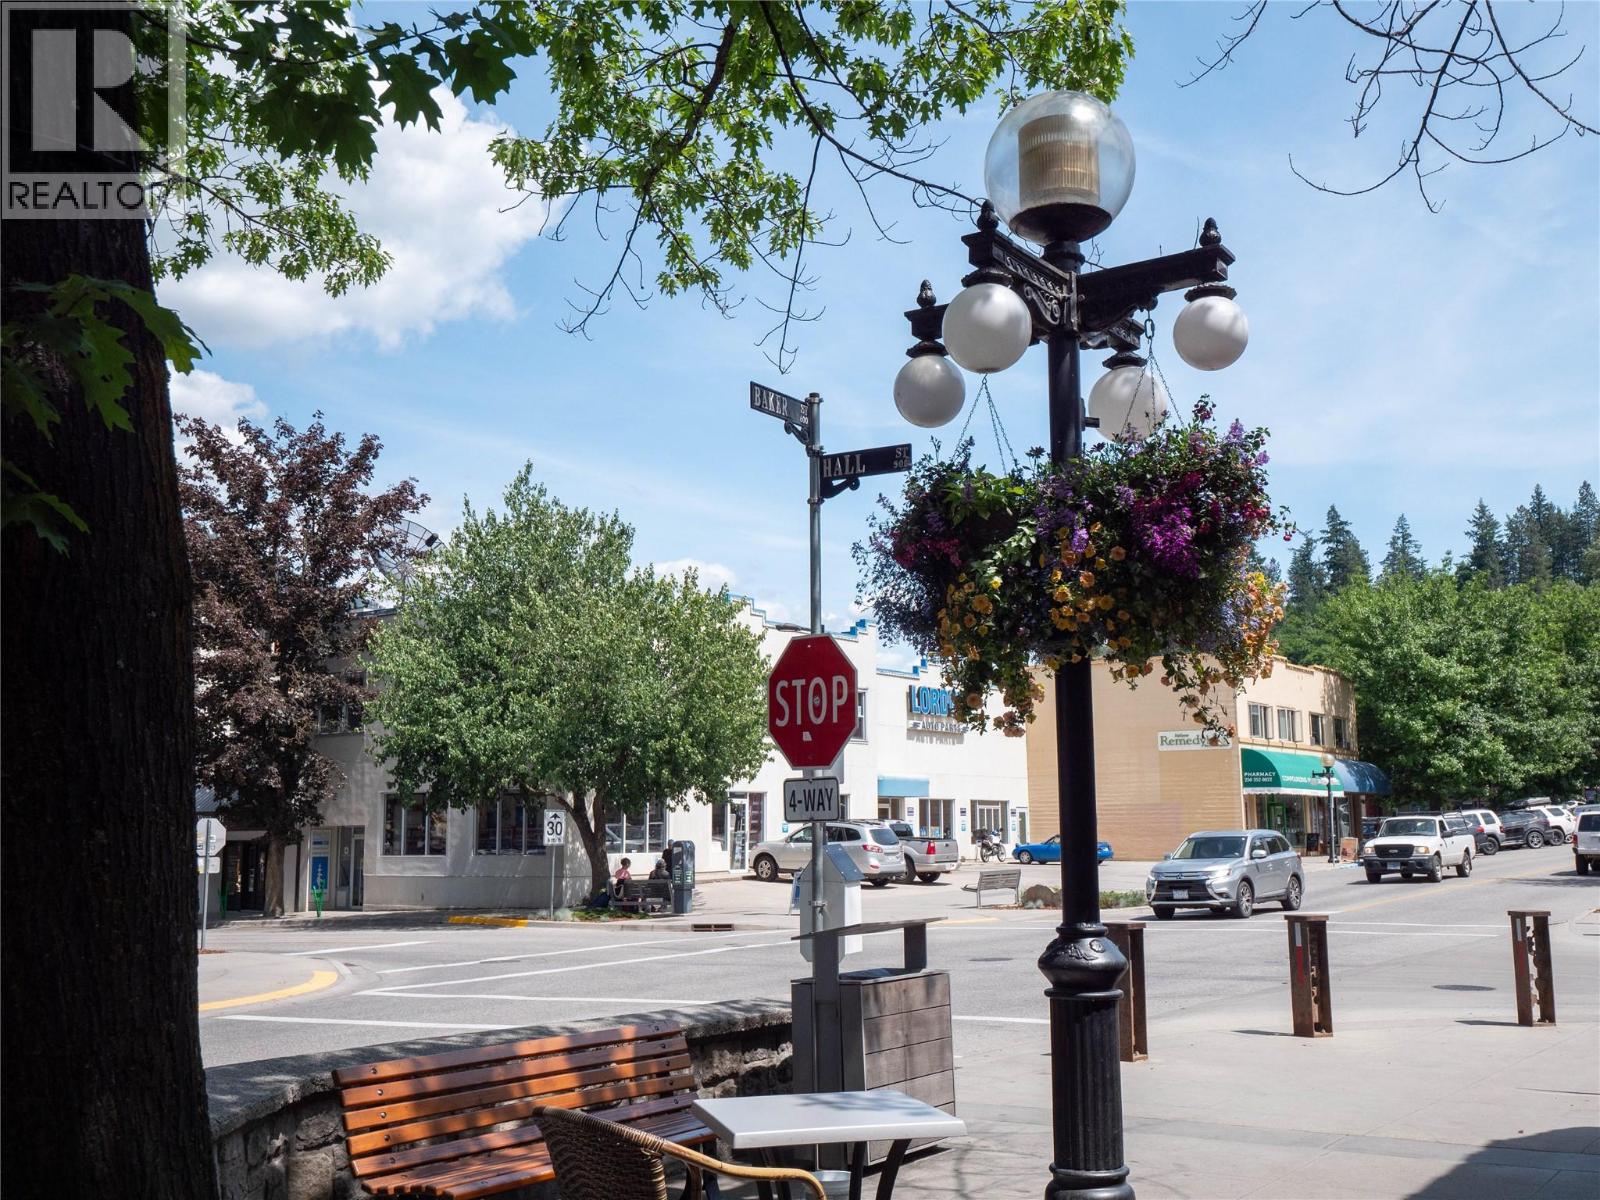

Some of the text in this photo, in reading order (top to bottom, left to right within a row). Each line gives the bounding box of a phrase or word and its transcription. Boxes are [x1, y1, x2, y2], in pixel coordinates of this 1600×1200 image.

[754, 386, 788, 417] BAKER
[823, 446, 909, 478] HALL ST
[775, 675, 849, 728] STOP
[788, 787, 834, 813] 4-WAY
[547, 821, 563, 836] 30
